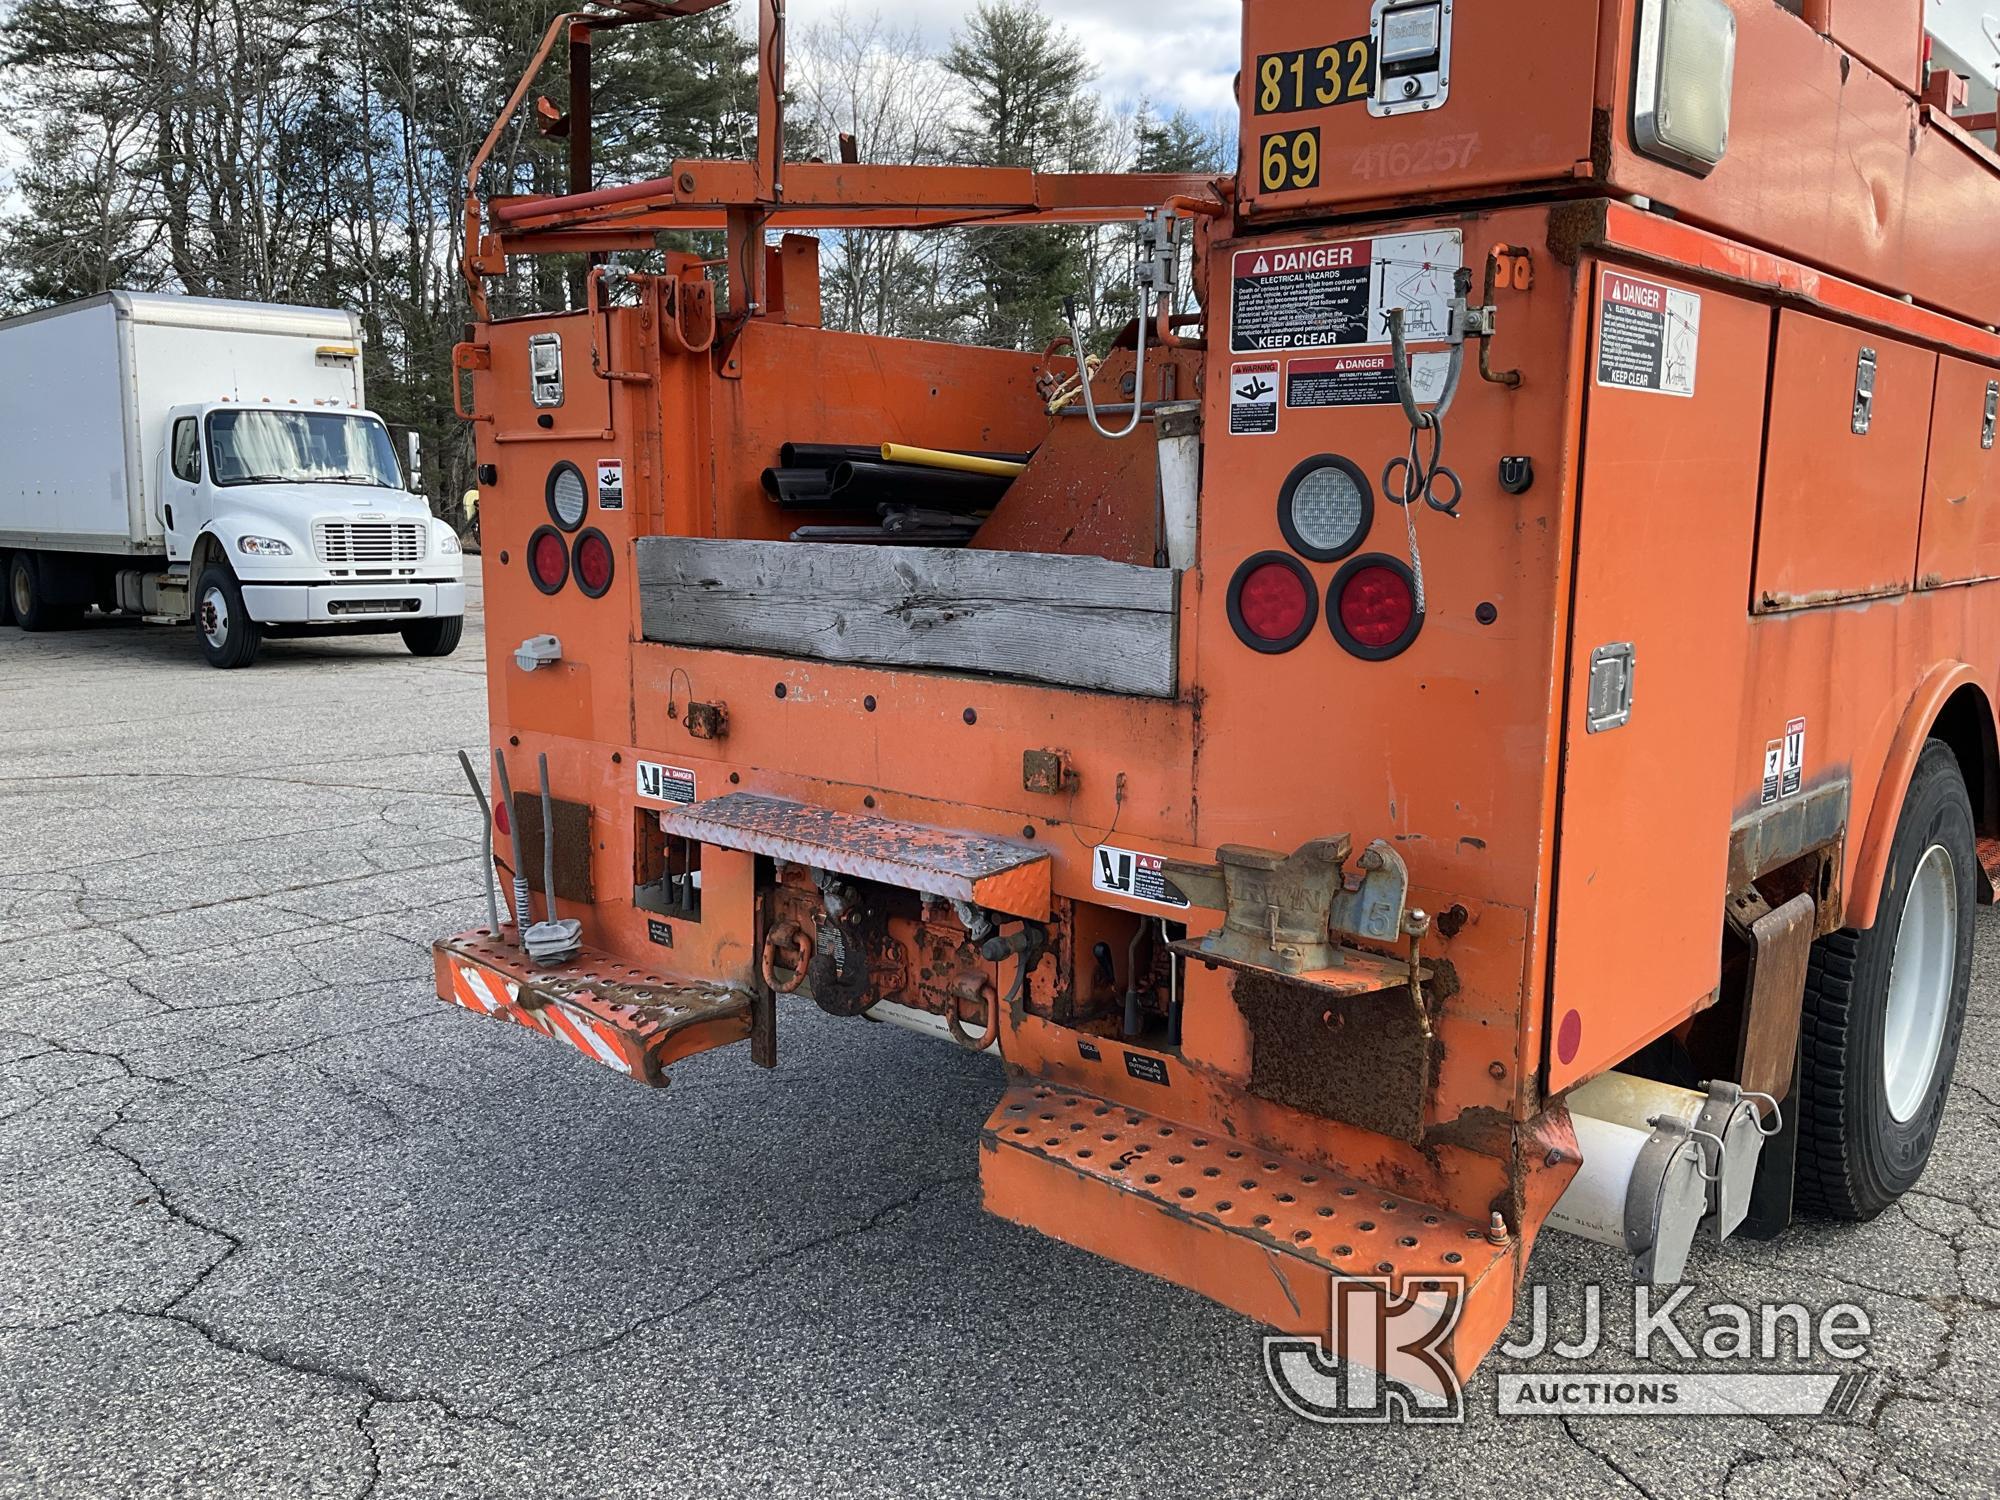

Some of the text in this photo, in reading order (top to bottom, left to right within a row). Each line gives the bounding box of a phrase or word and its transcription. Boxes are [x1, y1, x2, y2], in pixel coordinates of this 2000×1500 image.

[1260, 40, 1368, 112] 8132
[1262, 132, 1317, 190] 69
[1274, 248, 1352, 272] DANGER
[1260, 270, 1340, 284] ELECTRICAL HAZARDS
[1623, 284, 1659, 308] DANGER
[1258, 332, 1336, 348] KEEP CLEAR
[1242, 364, 1275, 372] WARNING
[1345, 358, 1384, 369] DANGER
[1612, 370, 1648, 386] KEEP CLEAR
[673, 771, 692, 779] DANGER
[1368, 902, 1390, 936] 5
